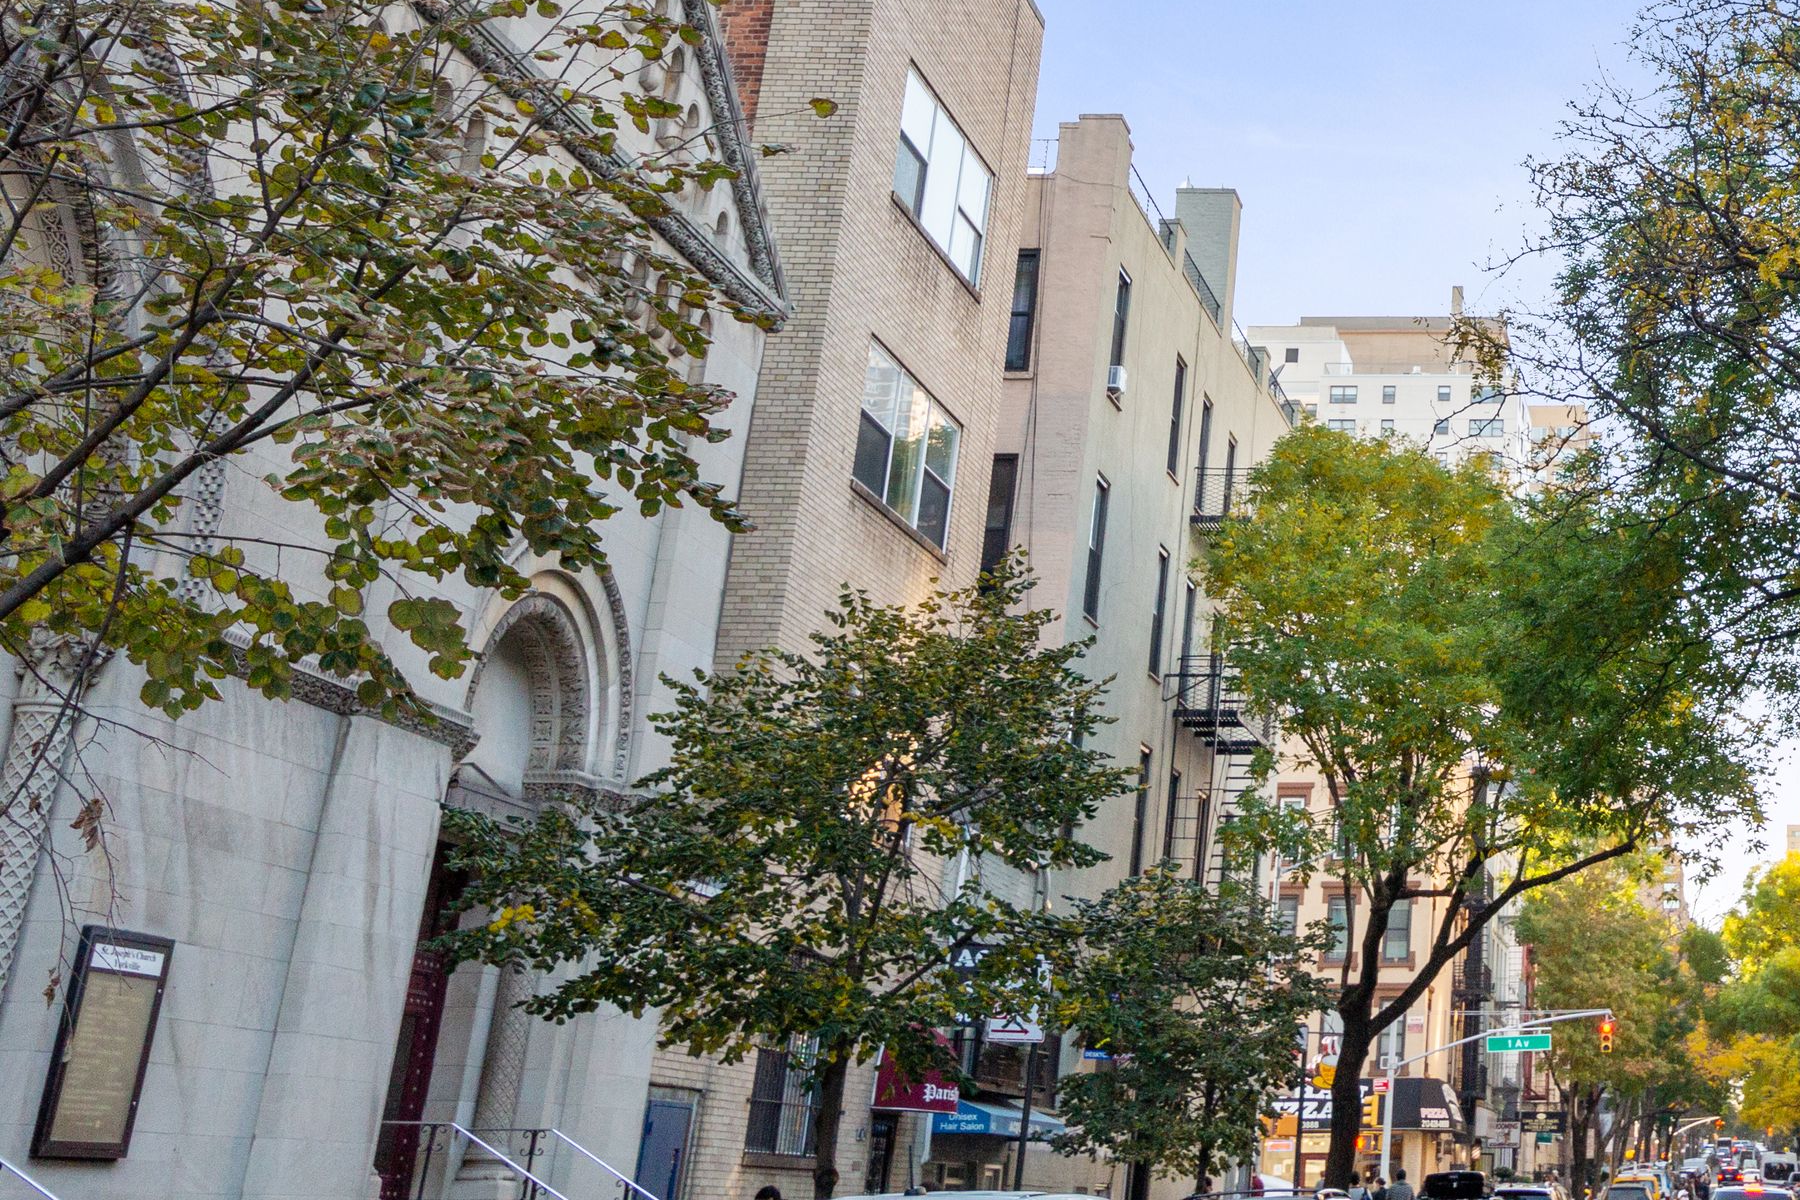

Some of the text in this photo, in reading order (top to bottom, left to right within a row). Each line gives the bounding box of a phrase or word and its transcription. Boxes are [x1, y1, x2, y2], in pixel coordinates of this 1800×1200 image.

[1507, 1038, 1530, 1048] 1 Av
[949, 1113, 978, 1122] Unisex
[1420, 1107, 1449, 1119] PIZZA
[940, 1122, 958, 1131] Hair
[959, 1122, 985, 1131] Salon
